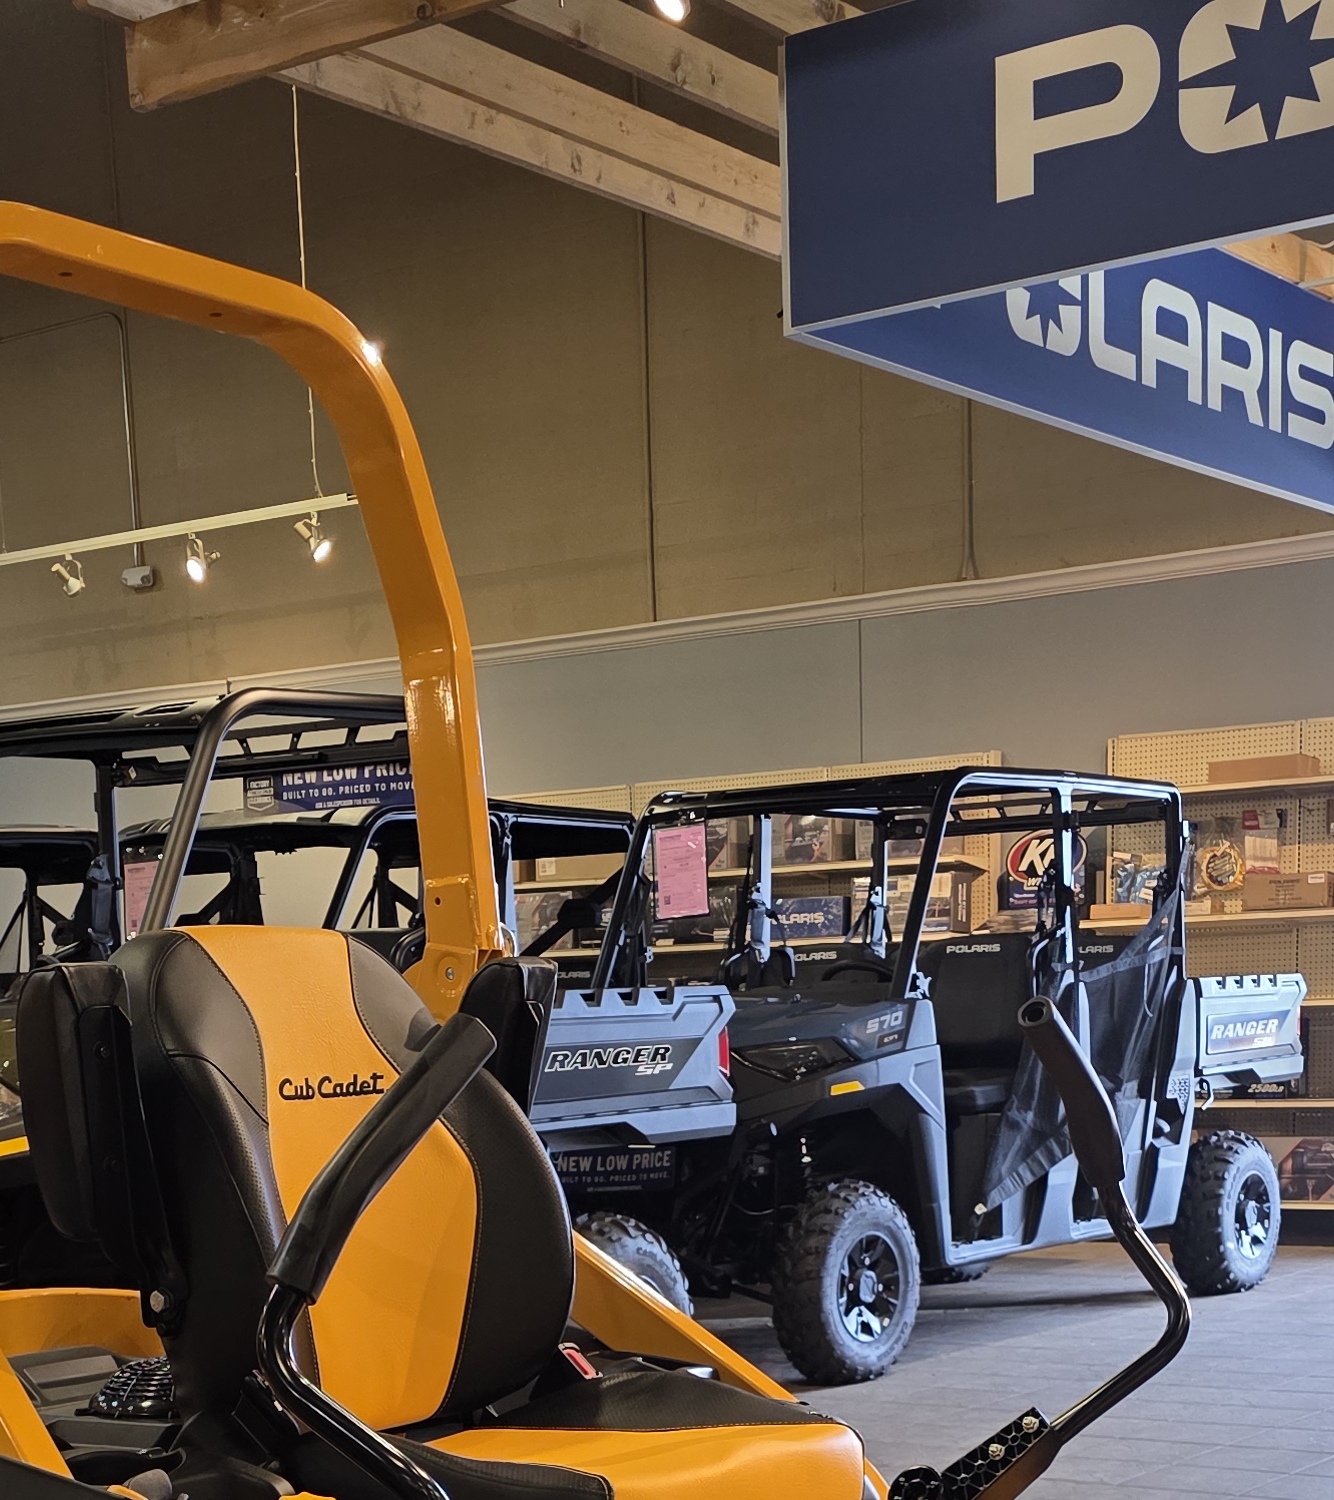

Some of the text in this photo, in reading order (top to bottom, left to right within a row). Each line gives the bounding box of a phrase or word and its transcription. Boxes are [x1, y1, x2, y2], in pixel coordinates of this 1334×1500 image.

[364, 763, 412, 778] PRIC
[282, 790, 305, 801] BUILT
[309, 788, 319, 797] TO
[339, 783, 371, 795] PRICED
[374, 783, 386, 792] TO
[794, 951, 837, 962] OLARIS
[946, 943, 1001, 954] POLARIS
[1078, 944, 1114, 954] LARIS
[557, 970, 591, 979] OLARIS
[866, 1011, 903, 1034] 570
[1211, 1018, 1279, 1040] RANGER
[544, 1044, 672, 1072] RANGER
[634, 1063, 674, 1076] SP
[278, 1072, 385, 1101] Cub Cadet
[557, 1150, 672, 1172] NEW LOW PRICE
